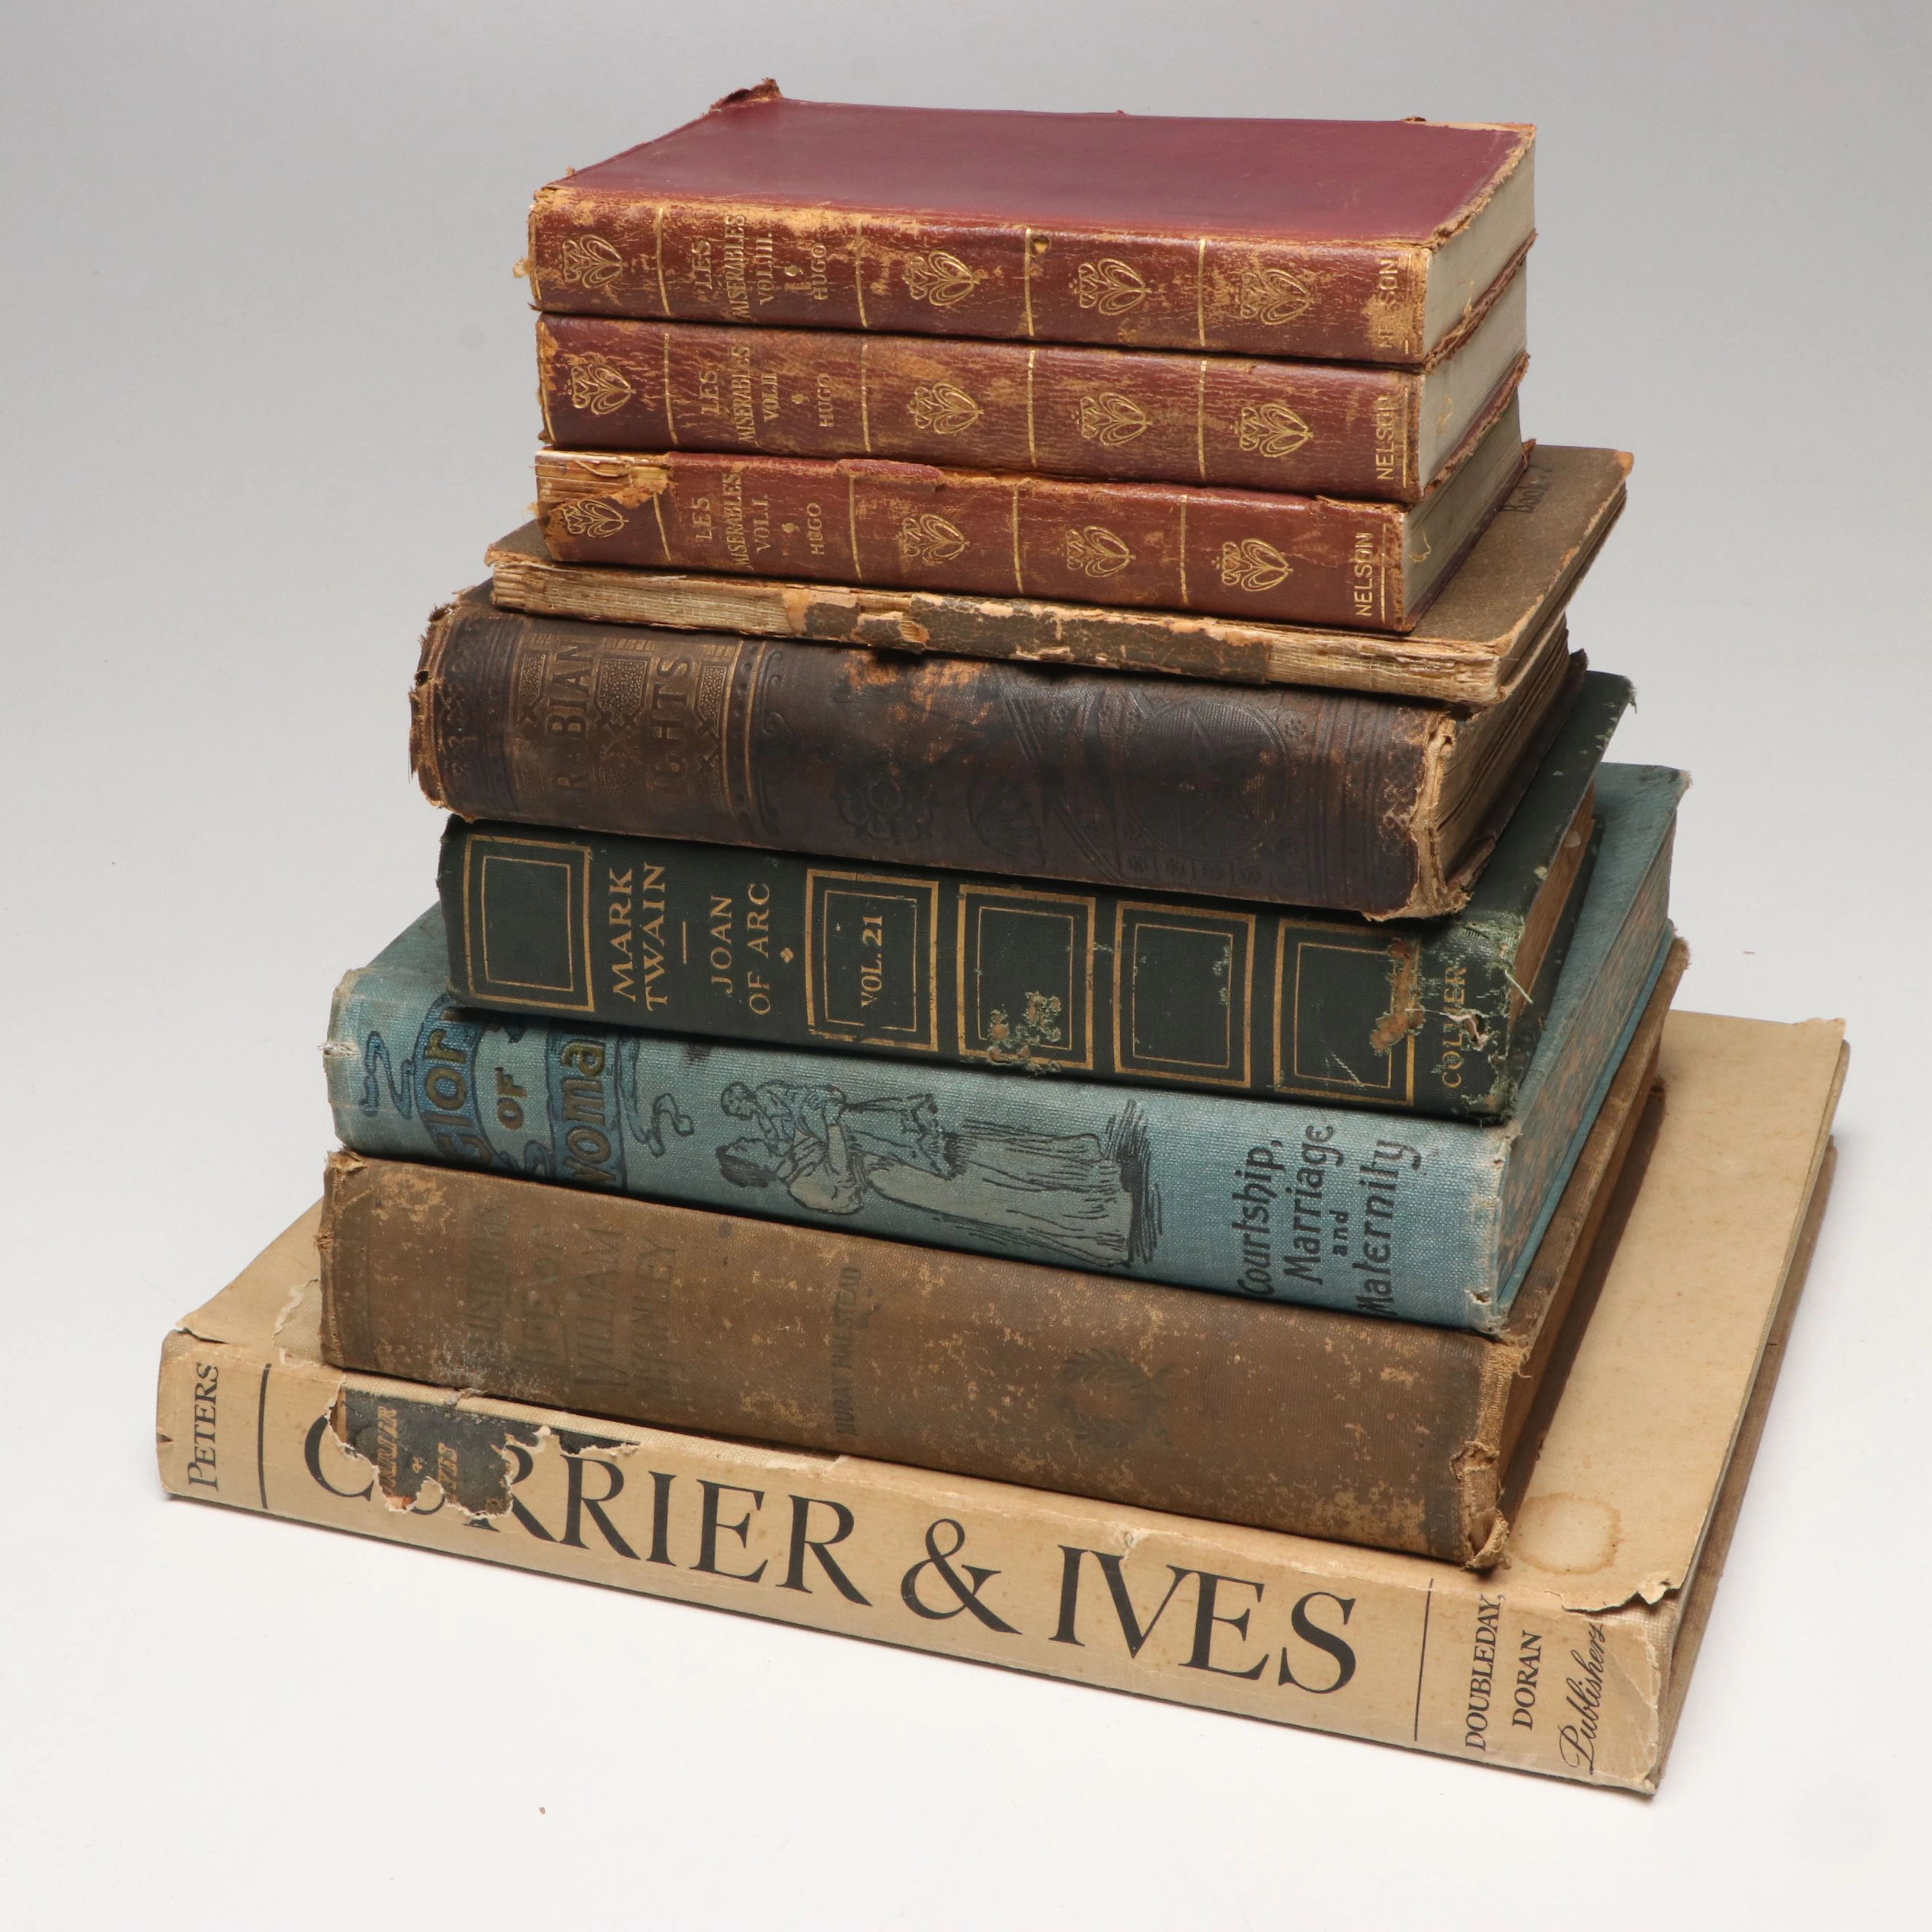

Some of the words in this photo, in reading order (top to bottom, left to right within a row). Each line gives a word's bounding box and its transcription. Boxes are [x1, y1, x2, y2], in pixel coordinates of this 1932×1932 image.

[691, 240, 713, 290] LES
[811, 242, 828, 301] HUGO
[699, 370, 719, 416] LES
[817, 372, 835, 428] HUGO
[1375, 395, 1397, 480] NELSON
[692, 496, 713, 542] LES
[806, 502, 825, 555] HUGO
[1354, 532, 1374, 617] NELSON
[608, 868, 636, 1003] MARK
[642, 861, 669, 1012] TWAIN
[710, 895, 735, 995] JOAN
[747, 883, 770, 957] ARC
[862, 914, 883, 947] 21
[747, 971, 771, 1016] OF
[860, 952, 883, 1007] VOL.
[1231, 1140, 1286, 1297] Courtship,
[1283, 1125, 1344, 1285] Marriage
[1329, 1210, 1349, 1257] and
[1351, 1140, 1422, 1317] Maternity
[187, 1361, 219, 1492] PETERS
[900, 1517, 1023, 1635] &
[1048, 1544, 1357, 1694] IVES
[1465, 1593, 1506, 1751] DOUBLEDAY,
[1511, 1630, 1542, 1730] DORAN
[1558, 1622, 1605, 1775] Publishers
